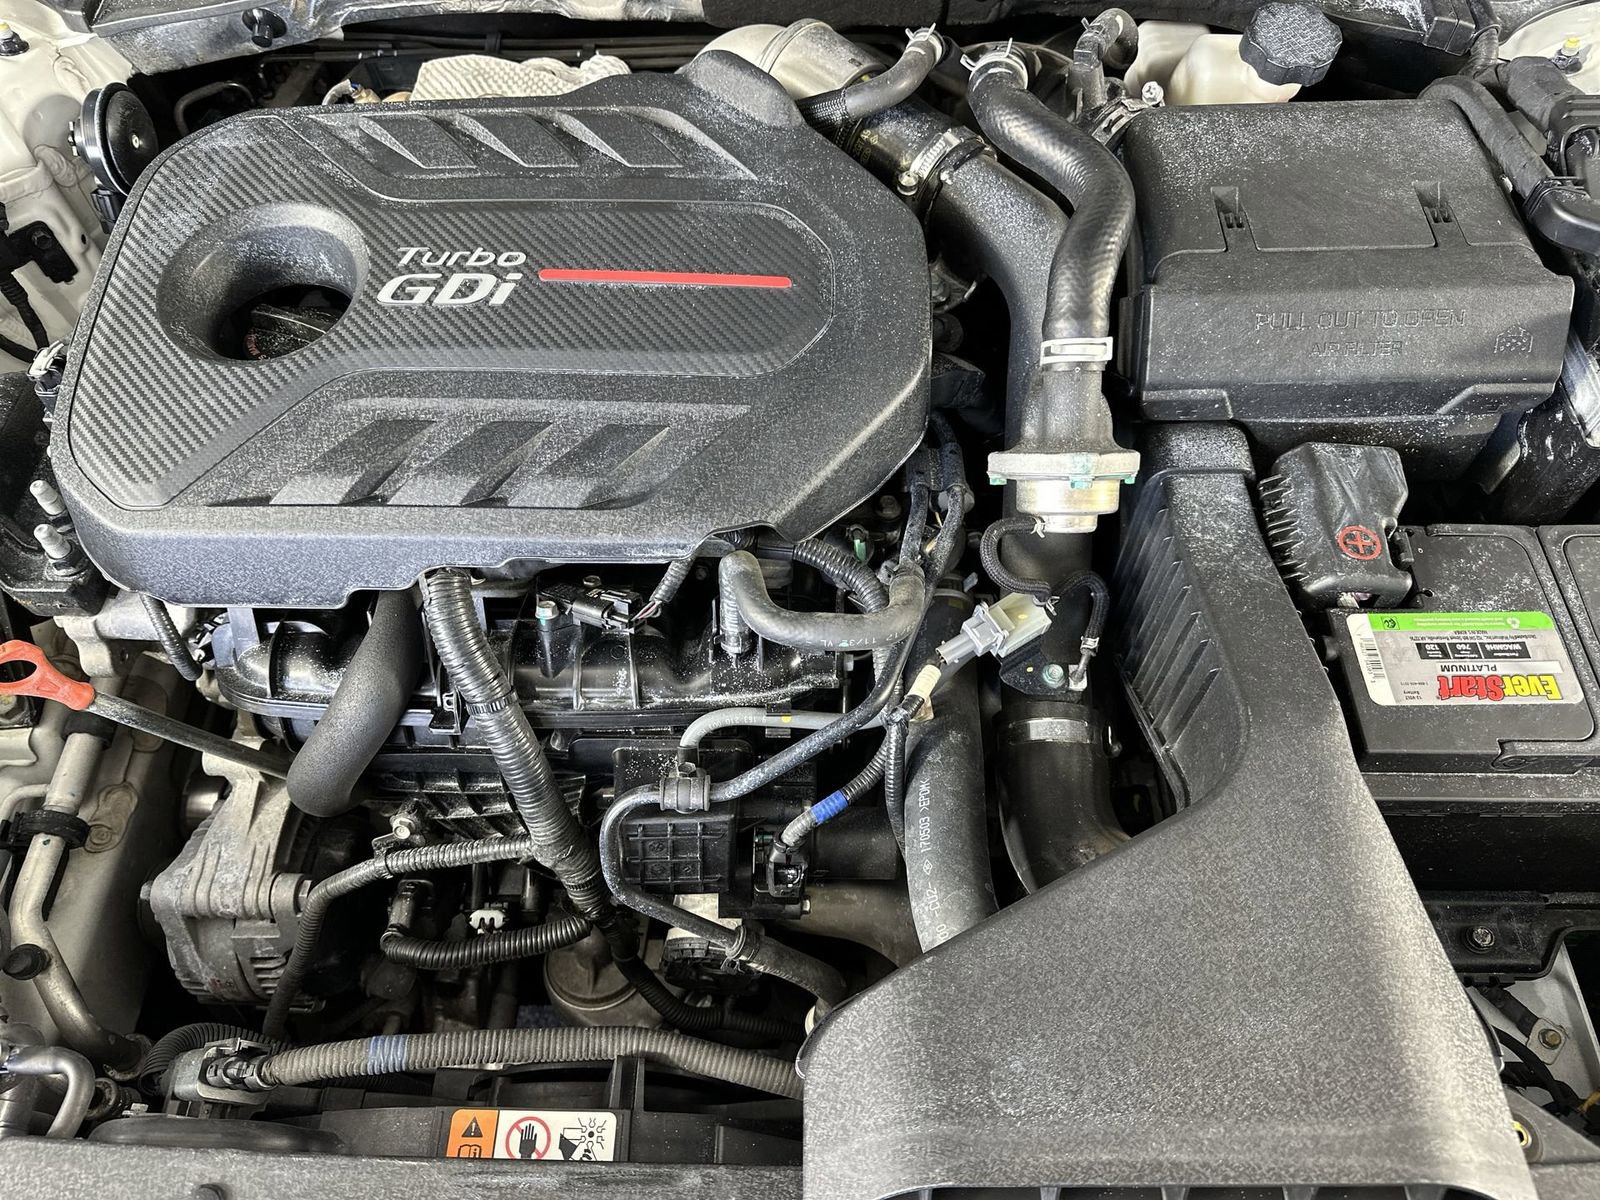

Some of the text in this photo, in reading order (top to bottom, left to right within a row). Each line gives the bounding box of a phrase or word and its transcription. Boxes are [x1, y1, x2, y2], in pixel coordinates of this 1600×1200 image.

[397, 246, 527, 267] Turbo
[376, 272, 523, 306] GDi
[1254, 308, 1467, 331] PULL OUT TO OPEN
[1310, 339, 1403, 358] AIR FILTER
[820, 639, 834, 648] VL
[1440, 664, 1497, 673] PLATINUM
[1437, 675, 1563, 701] EverStart
[919, 816, 932, 853] 170503
